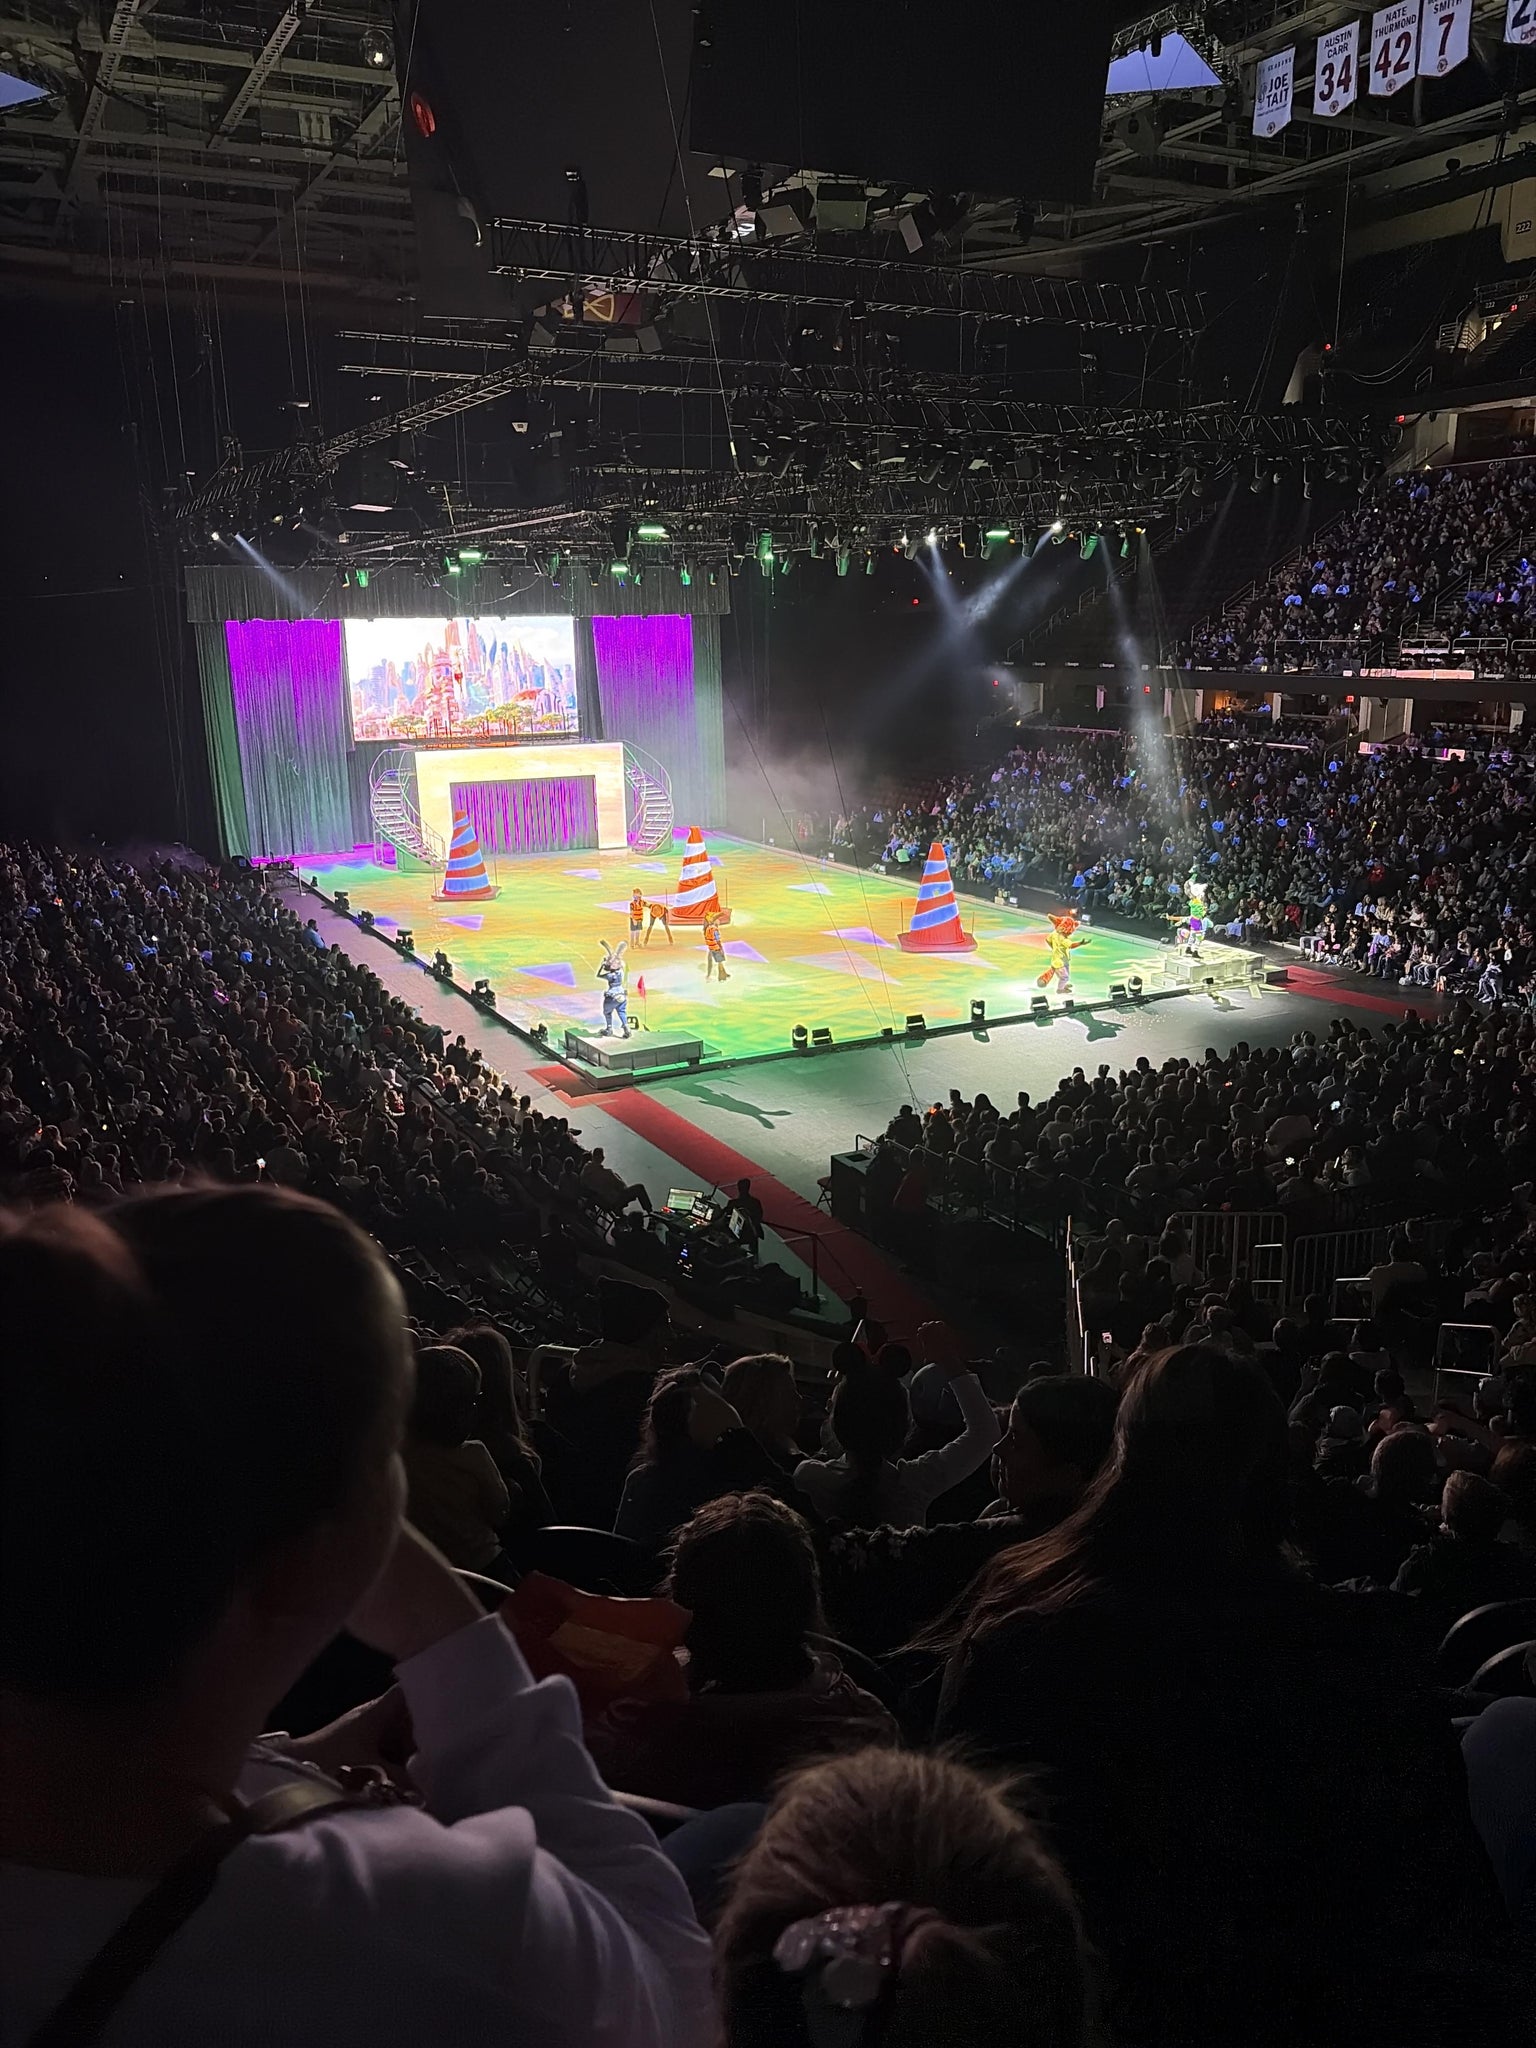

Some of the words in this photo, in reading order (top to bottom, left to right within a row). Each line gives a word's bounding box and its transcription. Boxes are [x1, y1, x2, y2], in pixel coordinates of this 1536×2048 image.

[1385, 6, 1408, 23] NATE
[1511, 0, 1536, 29] 2
[1375, 14, 1417, 39] THURMOND
[1438, 12, 1455, 56] 7
[1324, 30, 1352, 49] AUSTIN
[1327, 43, 1349, 58] CARR
[1374, 31, 1412, 78] 42
[1268, 73, 1289, 93] JOE
[1319, 54, 1352, 102] 34
[1266, 87, 1289, 108] TAIT
[1515, 221, 1531, 233] 222
